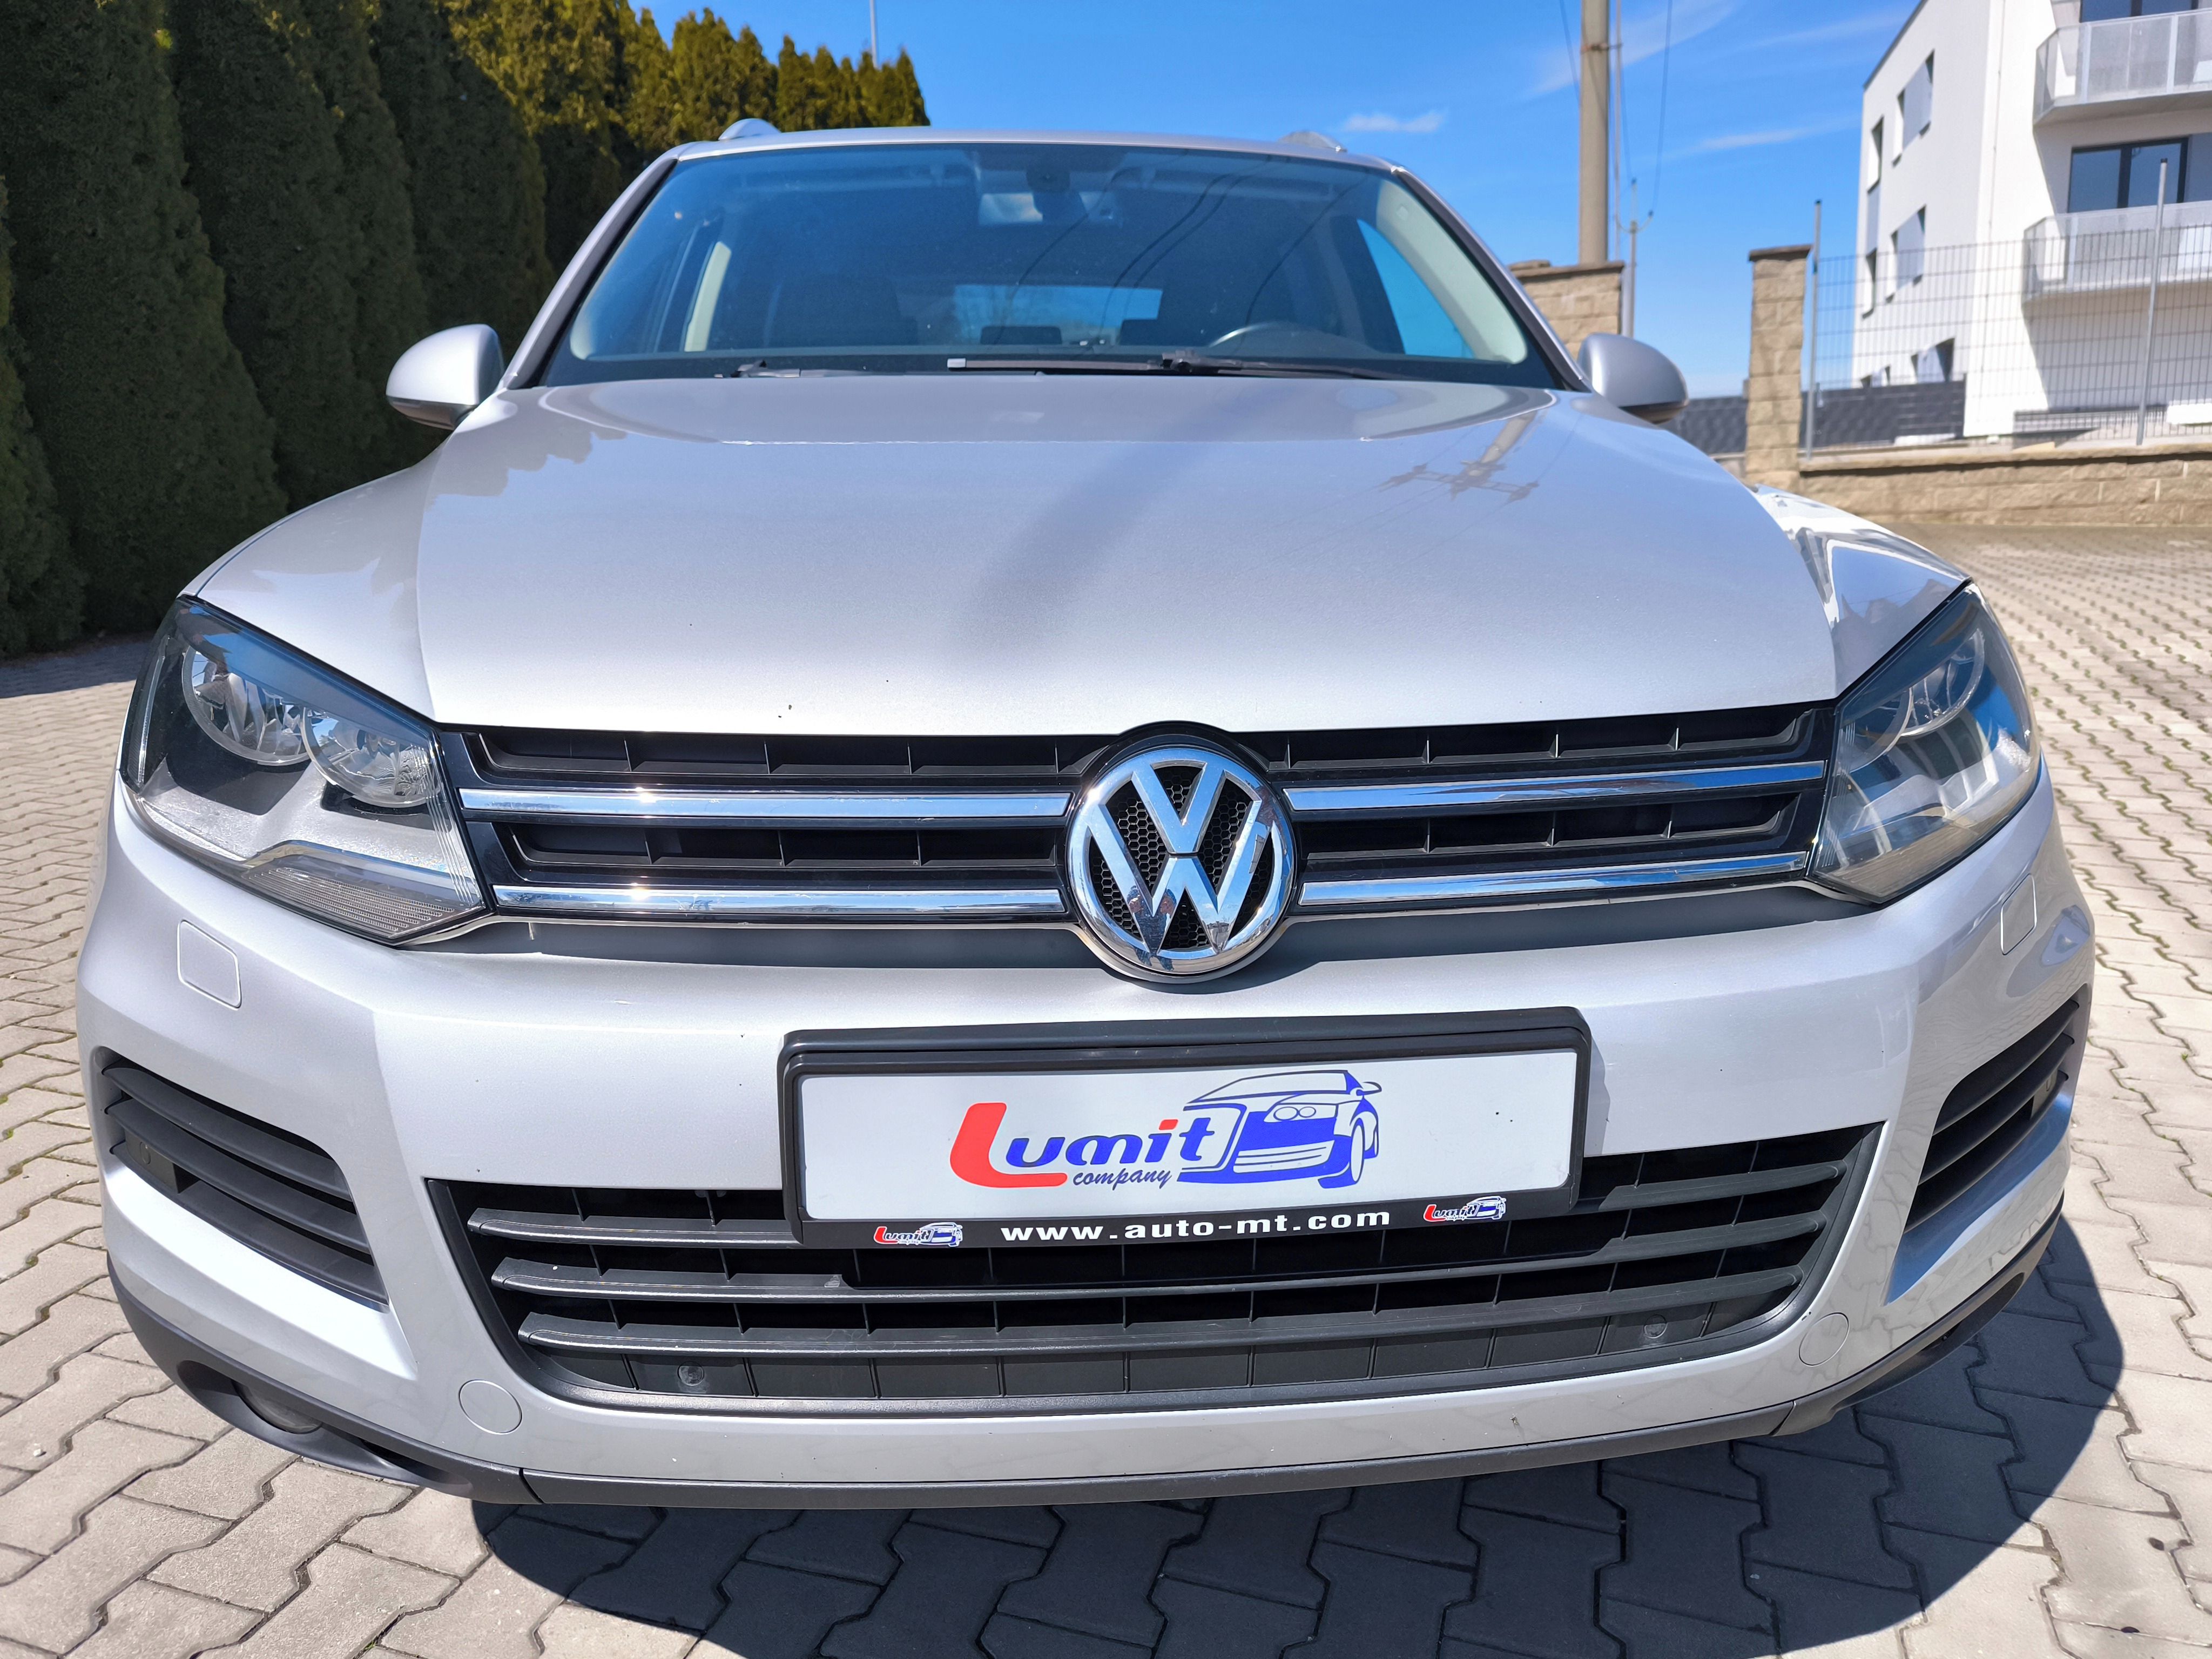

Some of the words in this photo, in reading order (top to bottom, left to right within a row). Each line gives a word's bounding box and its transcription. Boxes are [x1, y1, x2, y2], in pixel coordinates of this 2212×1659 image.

[1069, 748, 1293, 974] VW
[950, 1102, 1215, 1188] Lumit
[1073, 1168, 1172, 1190] company
[1001, 1211, 1390, 1241] www.auto-mt.com
